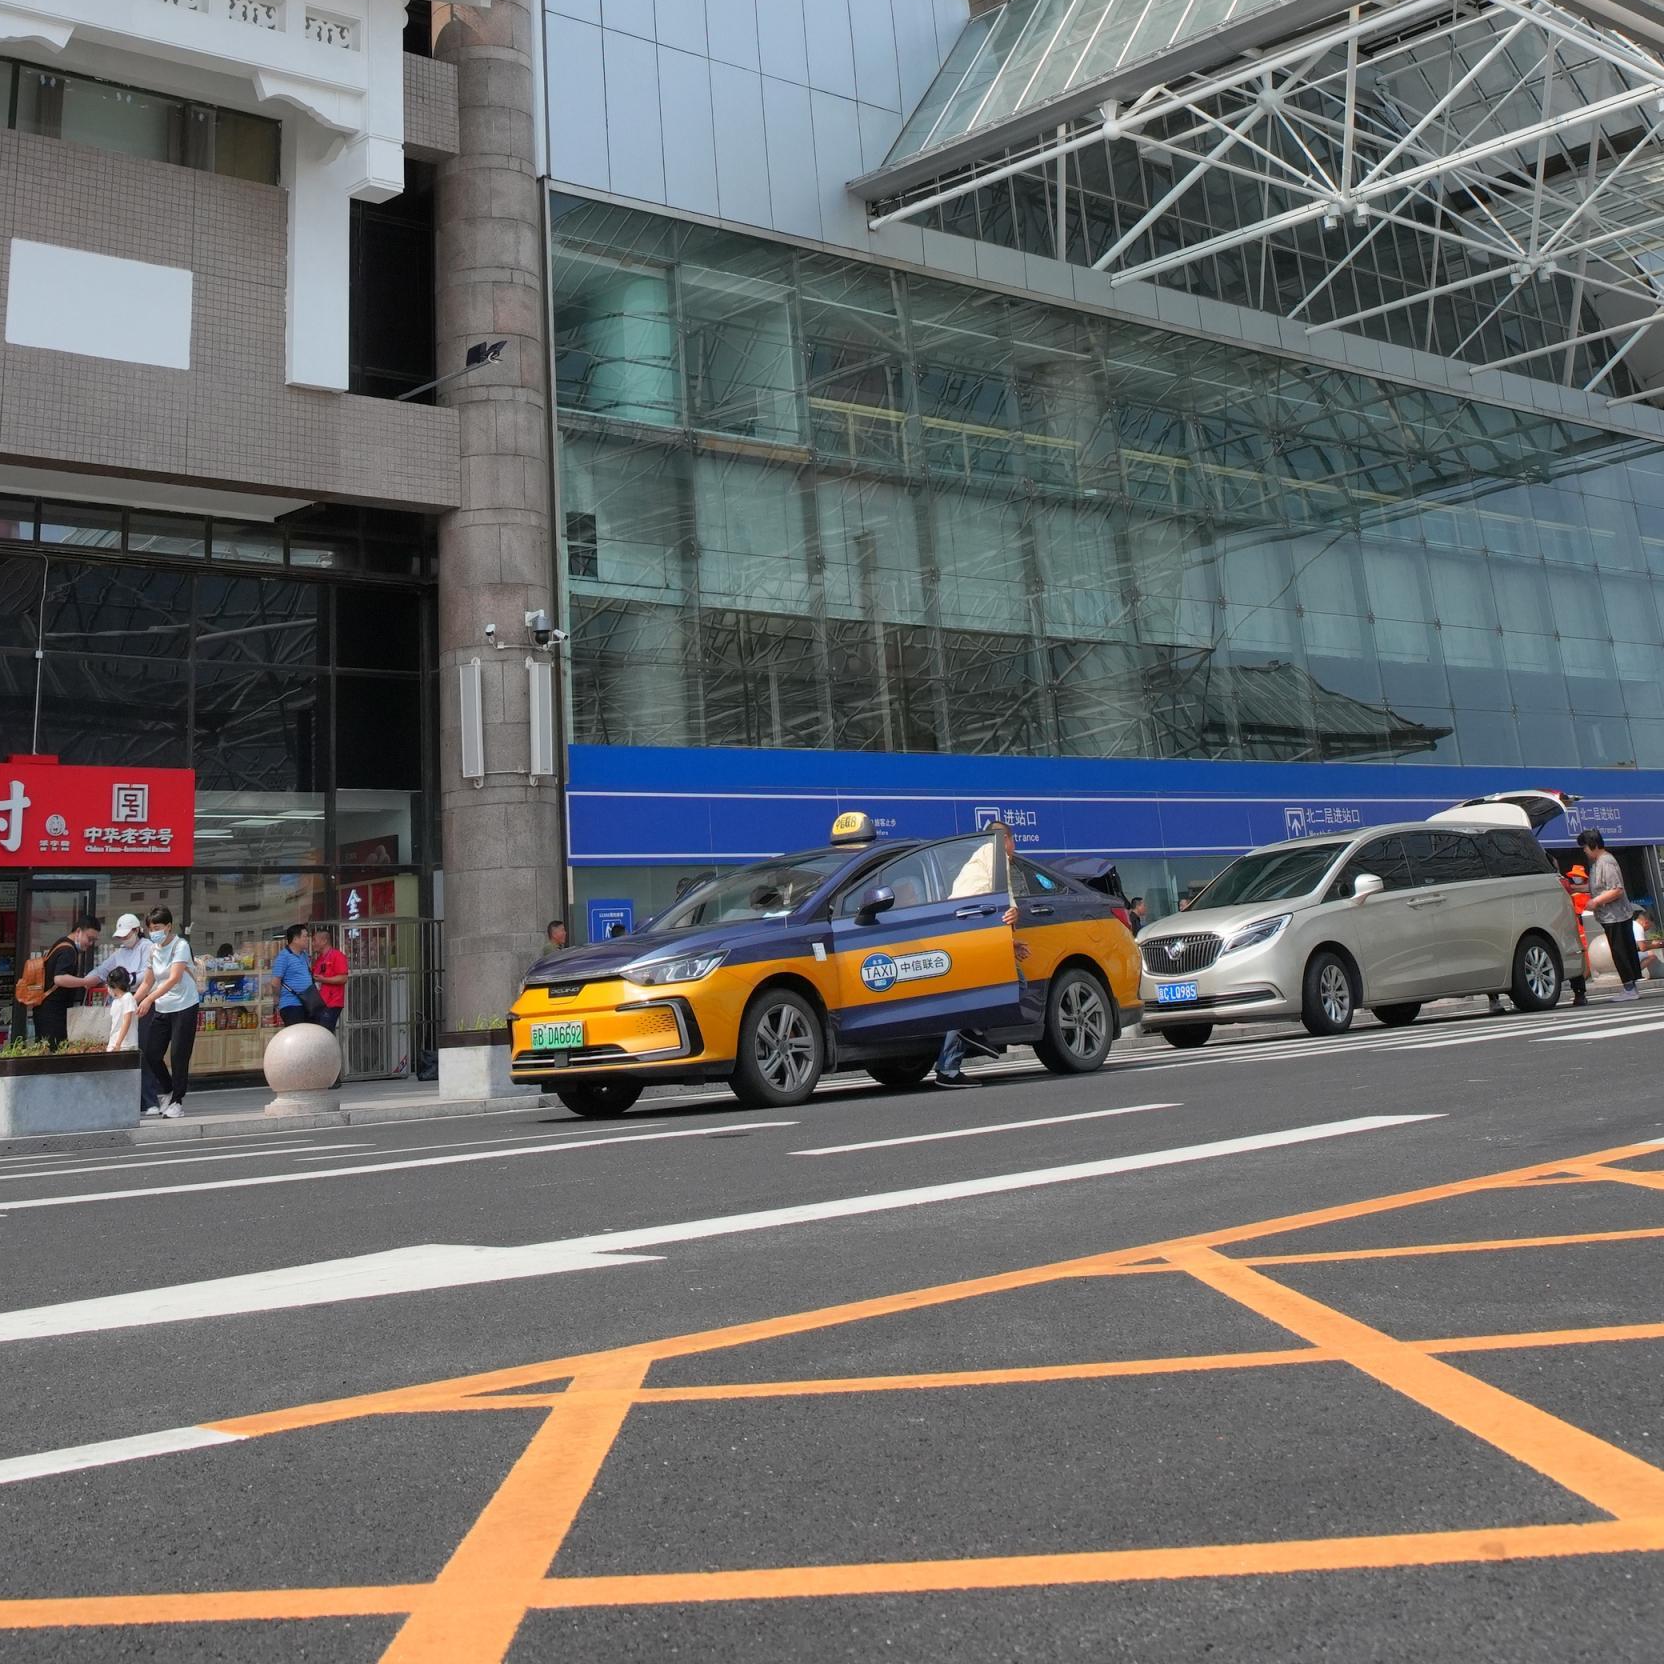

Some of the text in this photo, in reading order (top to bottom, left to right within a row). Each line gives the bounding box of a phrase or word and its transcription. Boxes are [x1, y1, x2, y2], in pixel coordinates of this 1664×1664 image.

[1003, 808, 1037, 827] 进站口
[1305, 807, 1361, 824] 北二层进站口
[83, 826, 174, 845] 中华老字号
[1014, 833, 1040, 843] trance
[864, 964, 893, 979] TAXI
[900, 956, 945, 974] 中信联合
